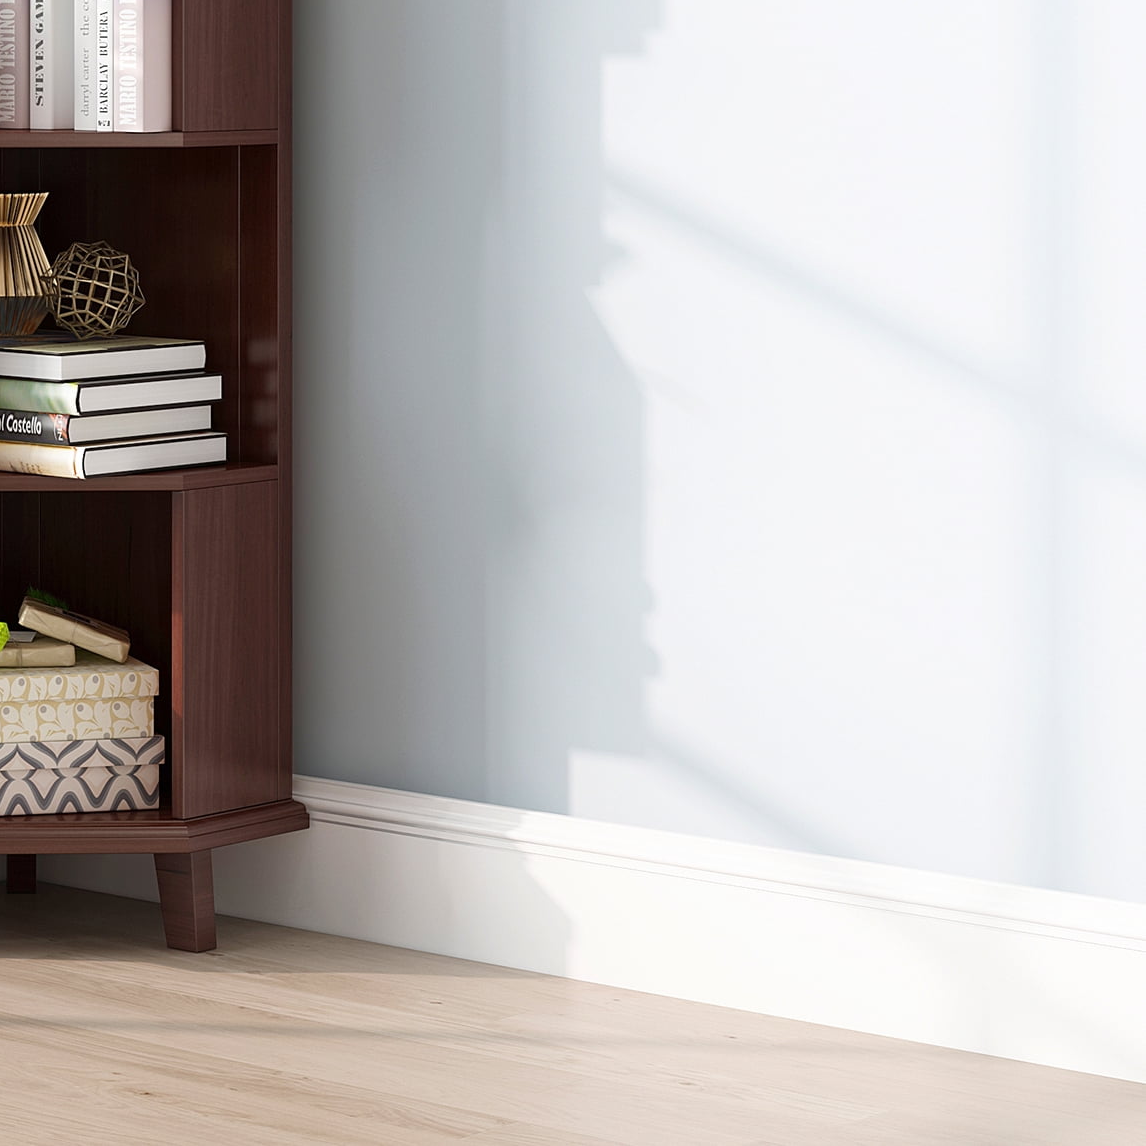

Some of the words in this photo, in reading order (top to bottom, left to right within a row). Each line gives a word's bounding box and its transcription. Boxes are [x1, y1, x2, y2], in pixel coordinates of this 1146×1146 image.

[79, 15, 90, 36] the
[99, 11, 108, 56] BUTERA
[118, 9, 137, 71] TESTINO
[35, 38, 45, 107] STEVEN
[81, 47, 90, 81] carter
[80, 83, 92, 117] darryl
[99, 62, 108, 114] BARCLAY
[118, 74, 137, 125] MARIO
[6, 414, 42, 435] Costello
